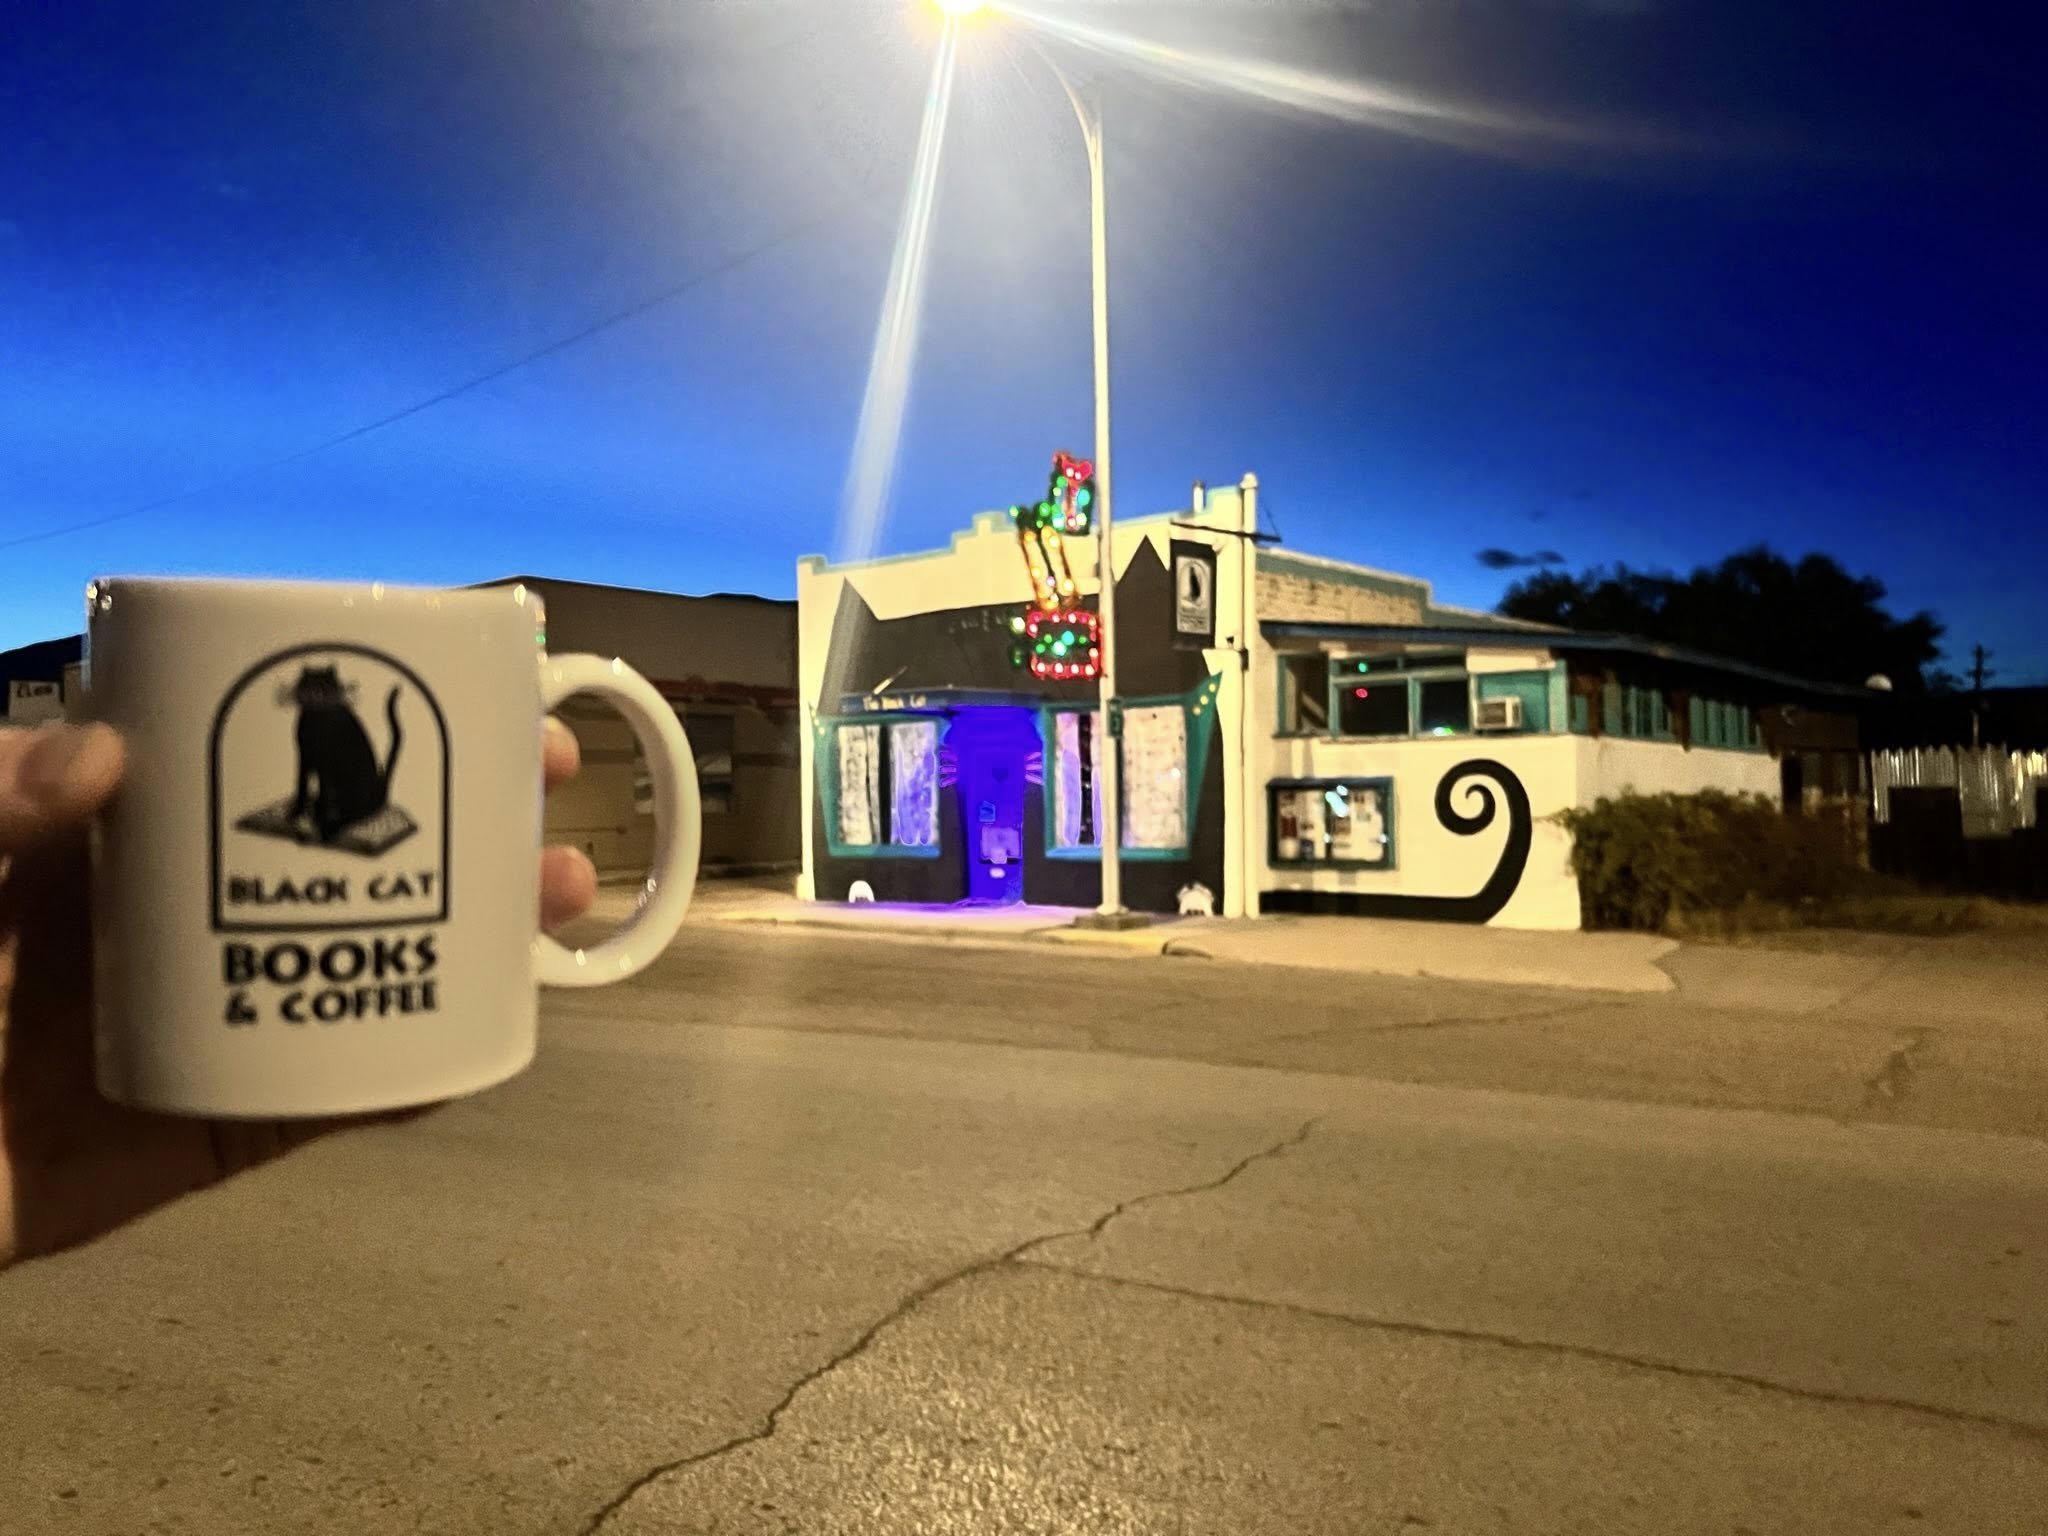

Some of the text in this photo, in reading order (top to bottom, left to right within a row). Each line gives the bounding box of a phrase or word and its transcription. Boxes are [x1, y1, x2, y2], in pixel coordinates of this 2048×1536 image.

[228, 871, 434, 903] BLACK CAT
[225, 932, 437, 985] BOOKS
[225, 981, 437, 1025] & COFFEE
